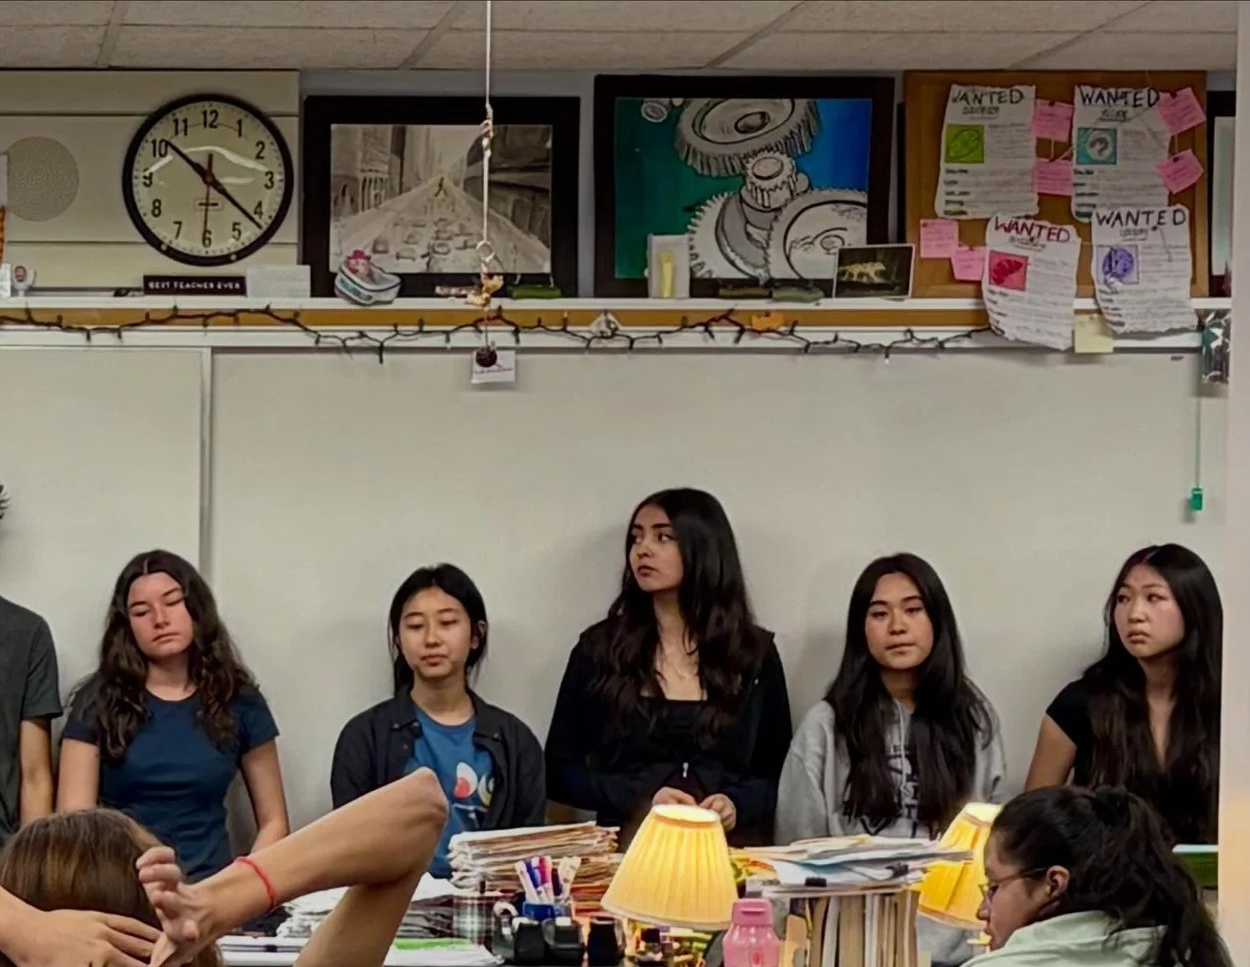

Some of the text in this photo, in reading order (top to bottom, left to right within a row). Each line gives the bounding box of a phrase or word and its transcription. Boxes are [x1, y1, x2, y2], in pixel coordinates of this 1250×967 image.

[1079, 85, 1160, 108] WANTED
[173, 117, 188, 136] 11
[202, 109, 219, 129] 12
[236, 119, 243, 138] 1
[151, 139, 168, 158] 10
[255, 141, 265, 160] 2
[142, 168, 153, 188] 9
[264, 171, 275, 190] 3
[151, 199, 162, 218] 8
[253, 200, 263, 219] 4
[1095, 208, 1187, 228] WANTED
[173, 221, 183, 240] 7
[202, 229, 212, 248] 6
[231, 222, 242, 241] 5
[994, 216, 1071, 243] WANTED
